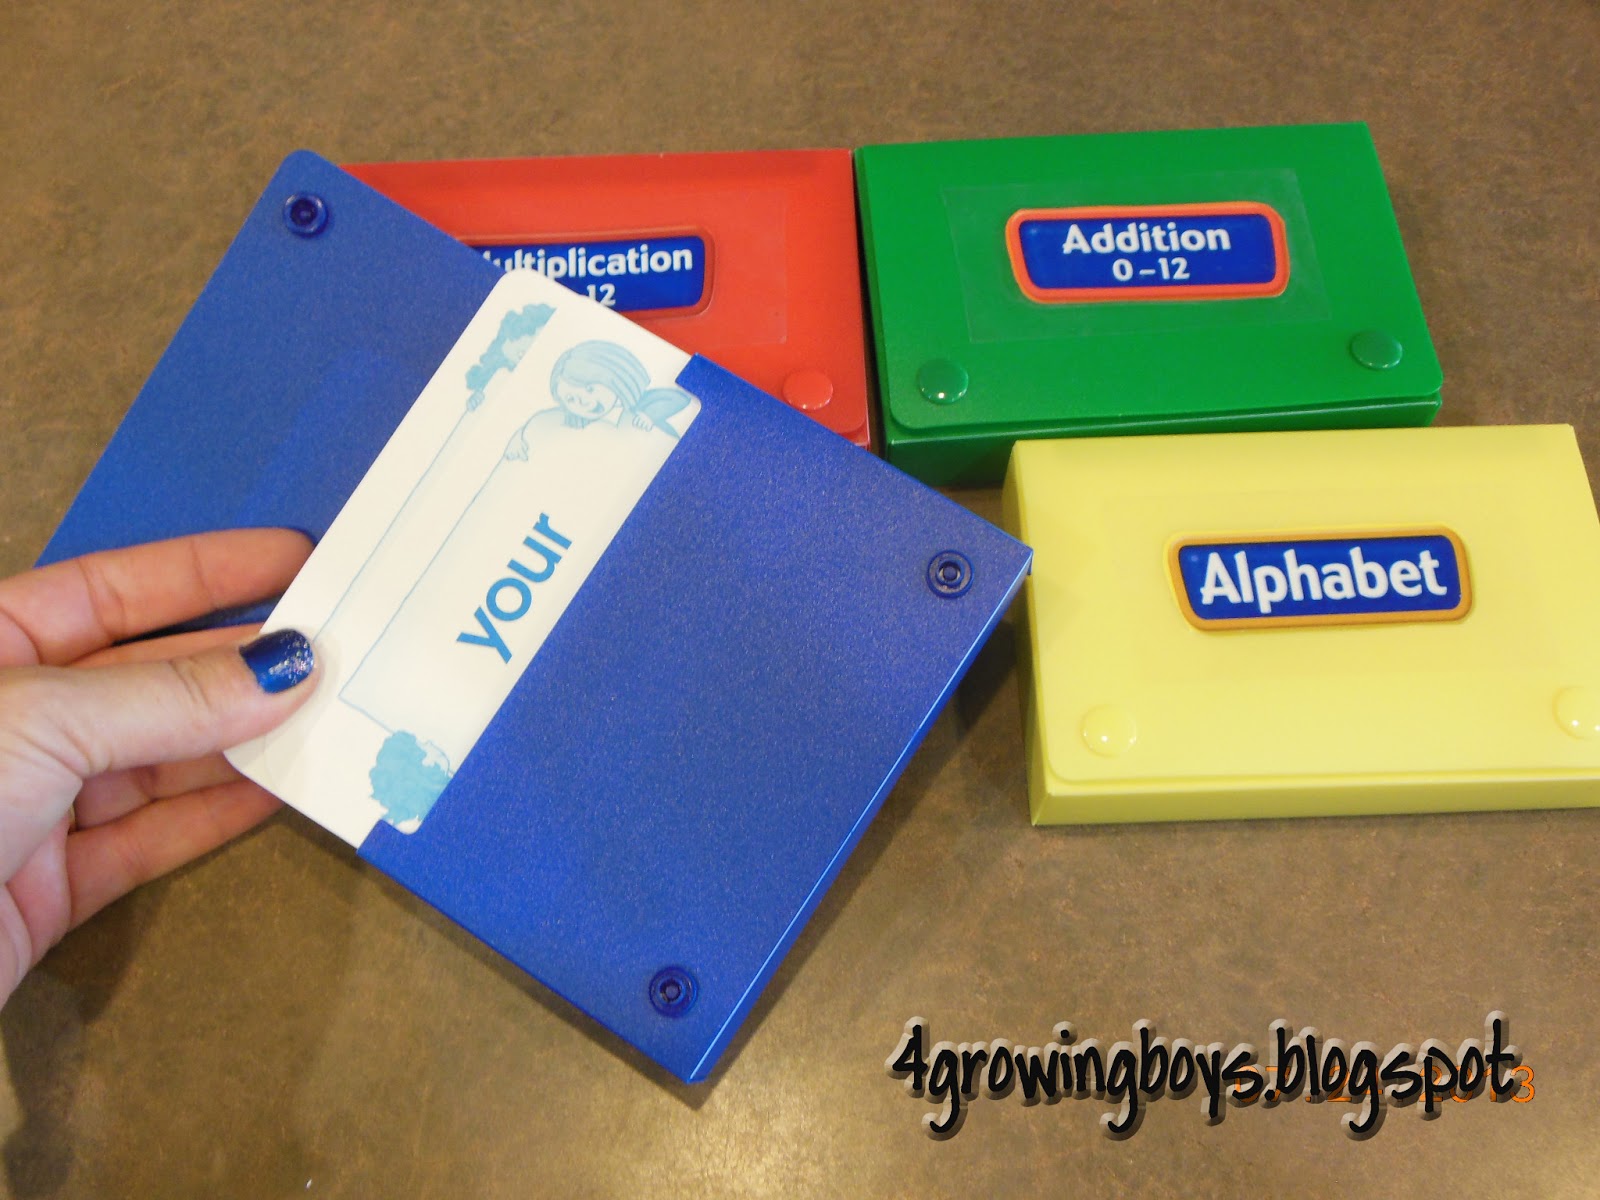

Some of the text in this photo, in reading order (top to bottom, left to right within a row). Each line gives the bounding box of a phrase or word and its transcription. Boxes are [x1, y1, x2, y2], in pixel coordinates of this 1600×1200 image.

[483, 243, 692, 281] ltiplication
[1062, 222, 1231, 254] Addition
[456, 512, 572, 664] your
[1200, 546, 1448, 614] Alphabet
